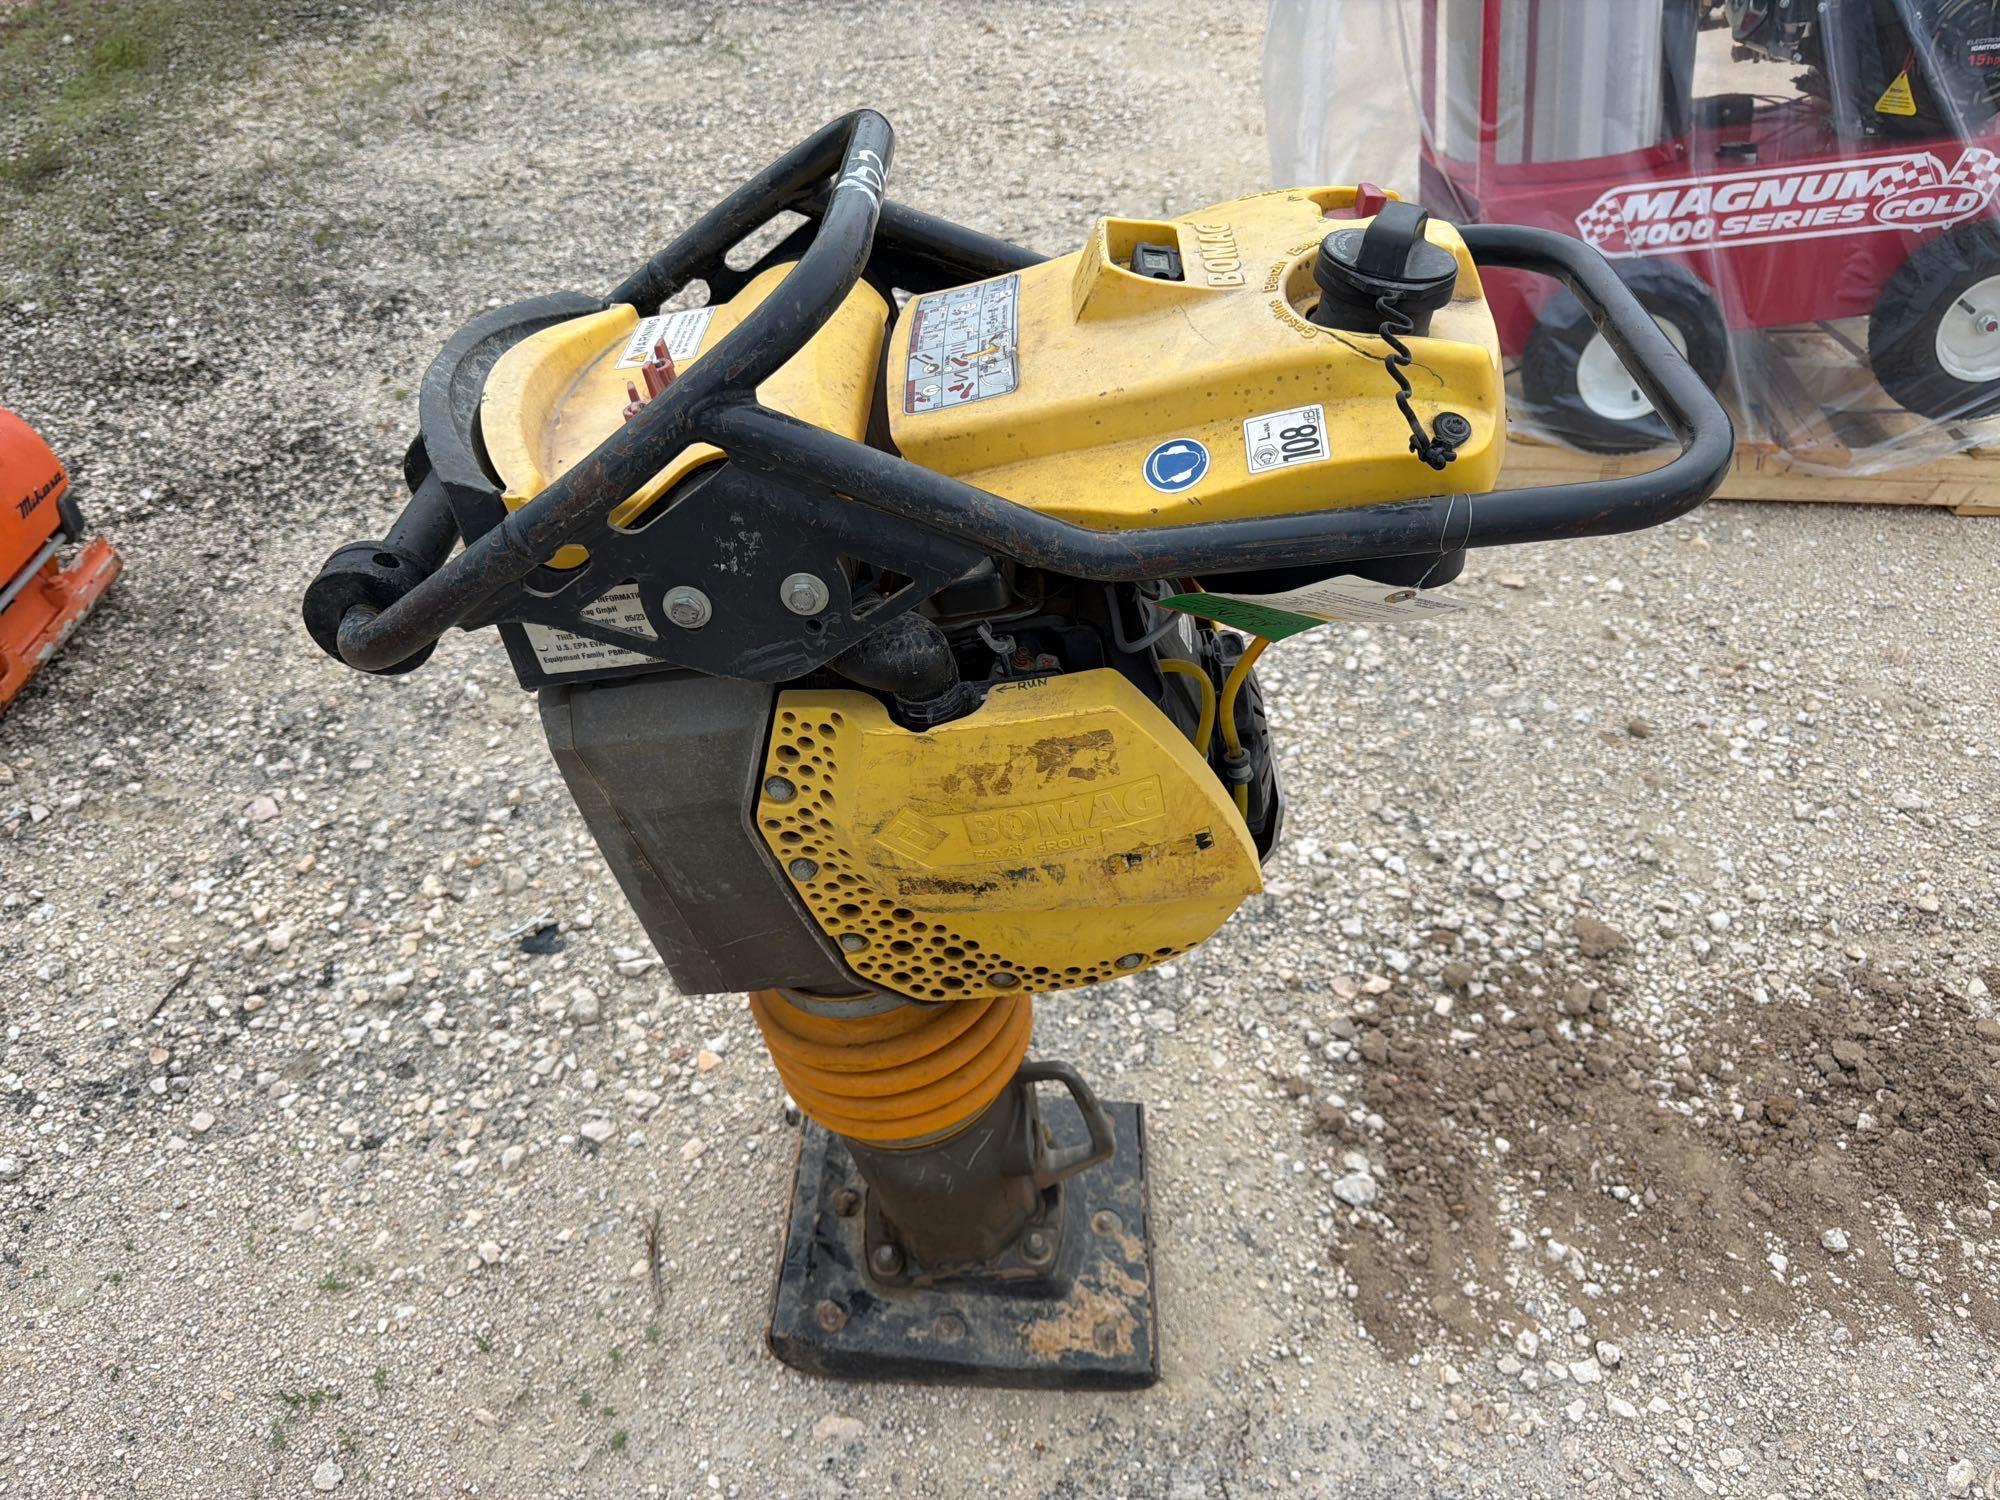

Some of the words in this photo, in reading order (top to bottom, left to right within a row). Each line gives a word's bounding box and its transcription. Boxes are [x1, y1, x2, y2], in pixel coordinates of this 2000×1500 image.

[1622, 165, 1903, 223] MAGNUM
[1879, 192, 1980, 220] GOLD
[1624, 217, 1716, 247] 4000
[1718, 203, 1870, 237] SERIES
[1194, 222, 1246, 287] BOMAG
[1262, 261, 1288, 293] Benzin
[1269, 299, 1318, 339] Gasoline
[631, 318, 660, 355] WARNING
[1280, 424, 1321, 462] 108
[1303, 410, 1316, 424] dB
[624, 614, 646, 622] 05/23
[556, 634, 577, 642] THIS
[556, 643, 573, 652] U.S.
[574, 641, 588, 649] EPA
[543, 654, 581, 665] Equipment
[582, 651, 605, 661] Family
[1018, 678, 1048, 690] RUN
[962, 780, 1157, 847] BOMAG
[1034, 833, 1098, 854] GROUP
